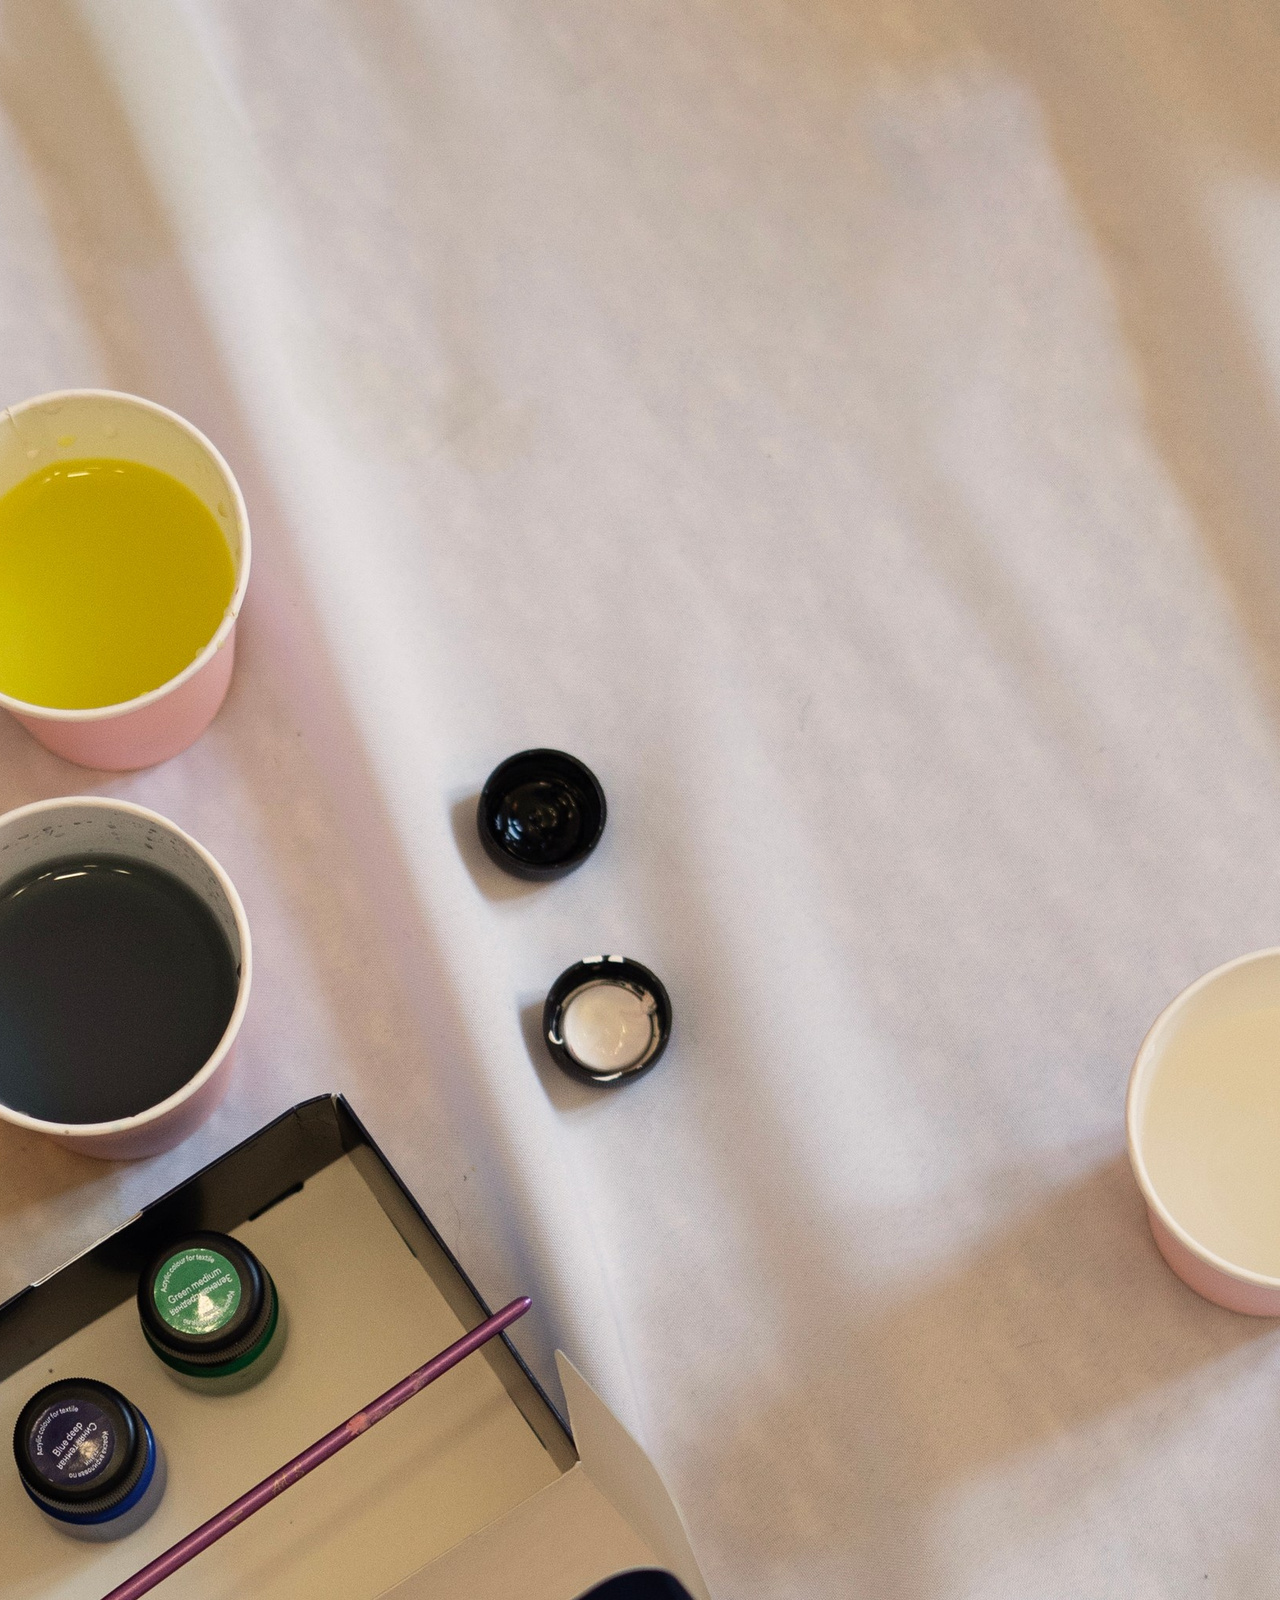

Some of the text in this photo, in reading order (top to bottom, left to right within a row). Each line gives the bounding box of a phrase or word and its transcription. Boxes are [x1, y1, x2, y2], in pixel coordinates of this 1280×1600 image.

[161, 1272, 171, 1292] Acrylic
[169, 1258, 185, 1273] colour
[196, 1255, 214, 1263] textile
[168, 1268, 221, 1303] Green medium
[39, 1417, 51, 1434] colour
[50, 1411, 60, 1419] for
[59, 1405, 78, 1414] textile
[52, 1422, 83, 1457] Blue deep
[57, 1423, 97, 1470] Синяя темная
